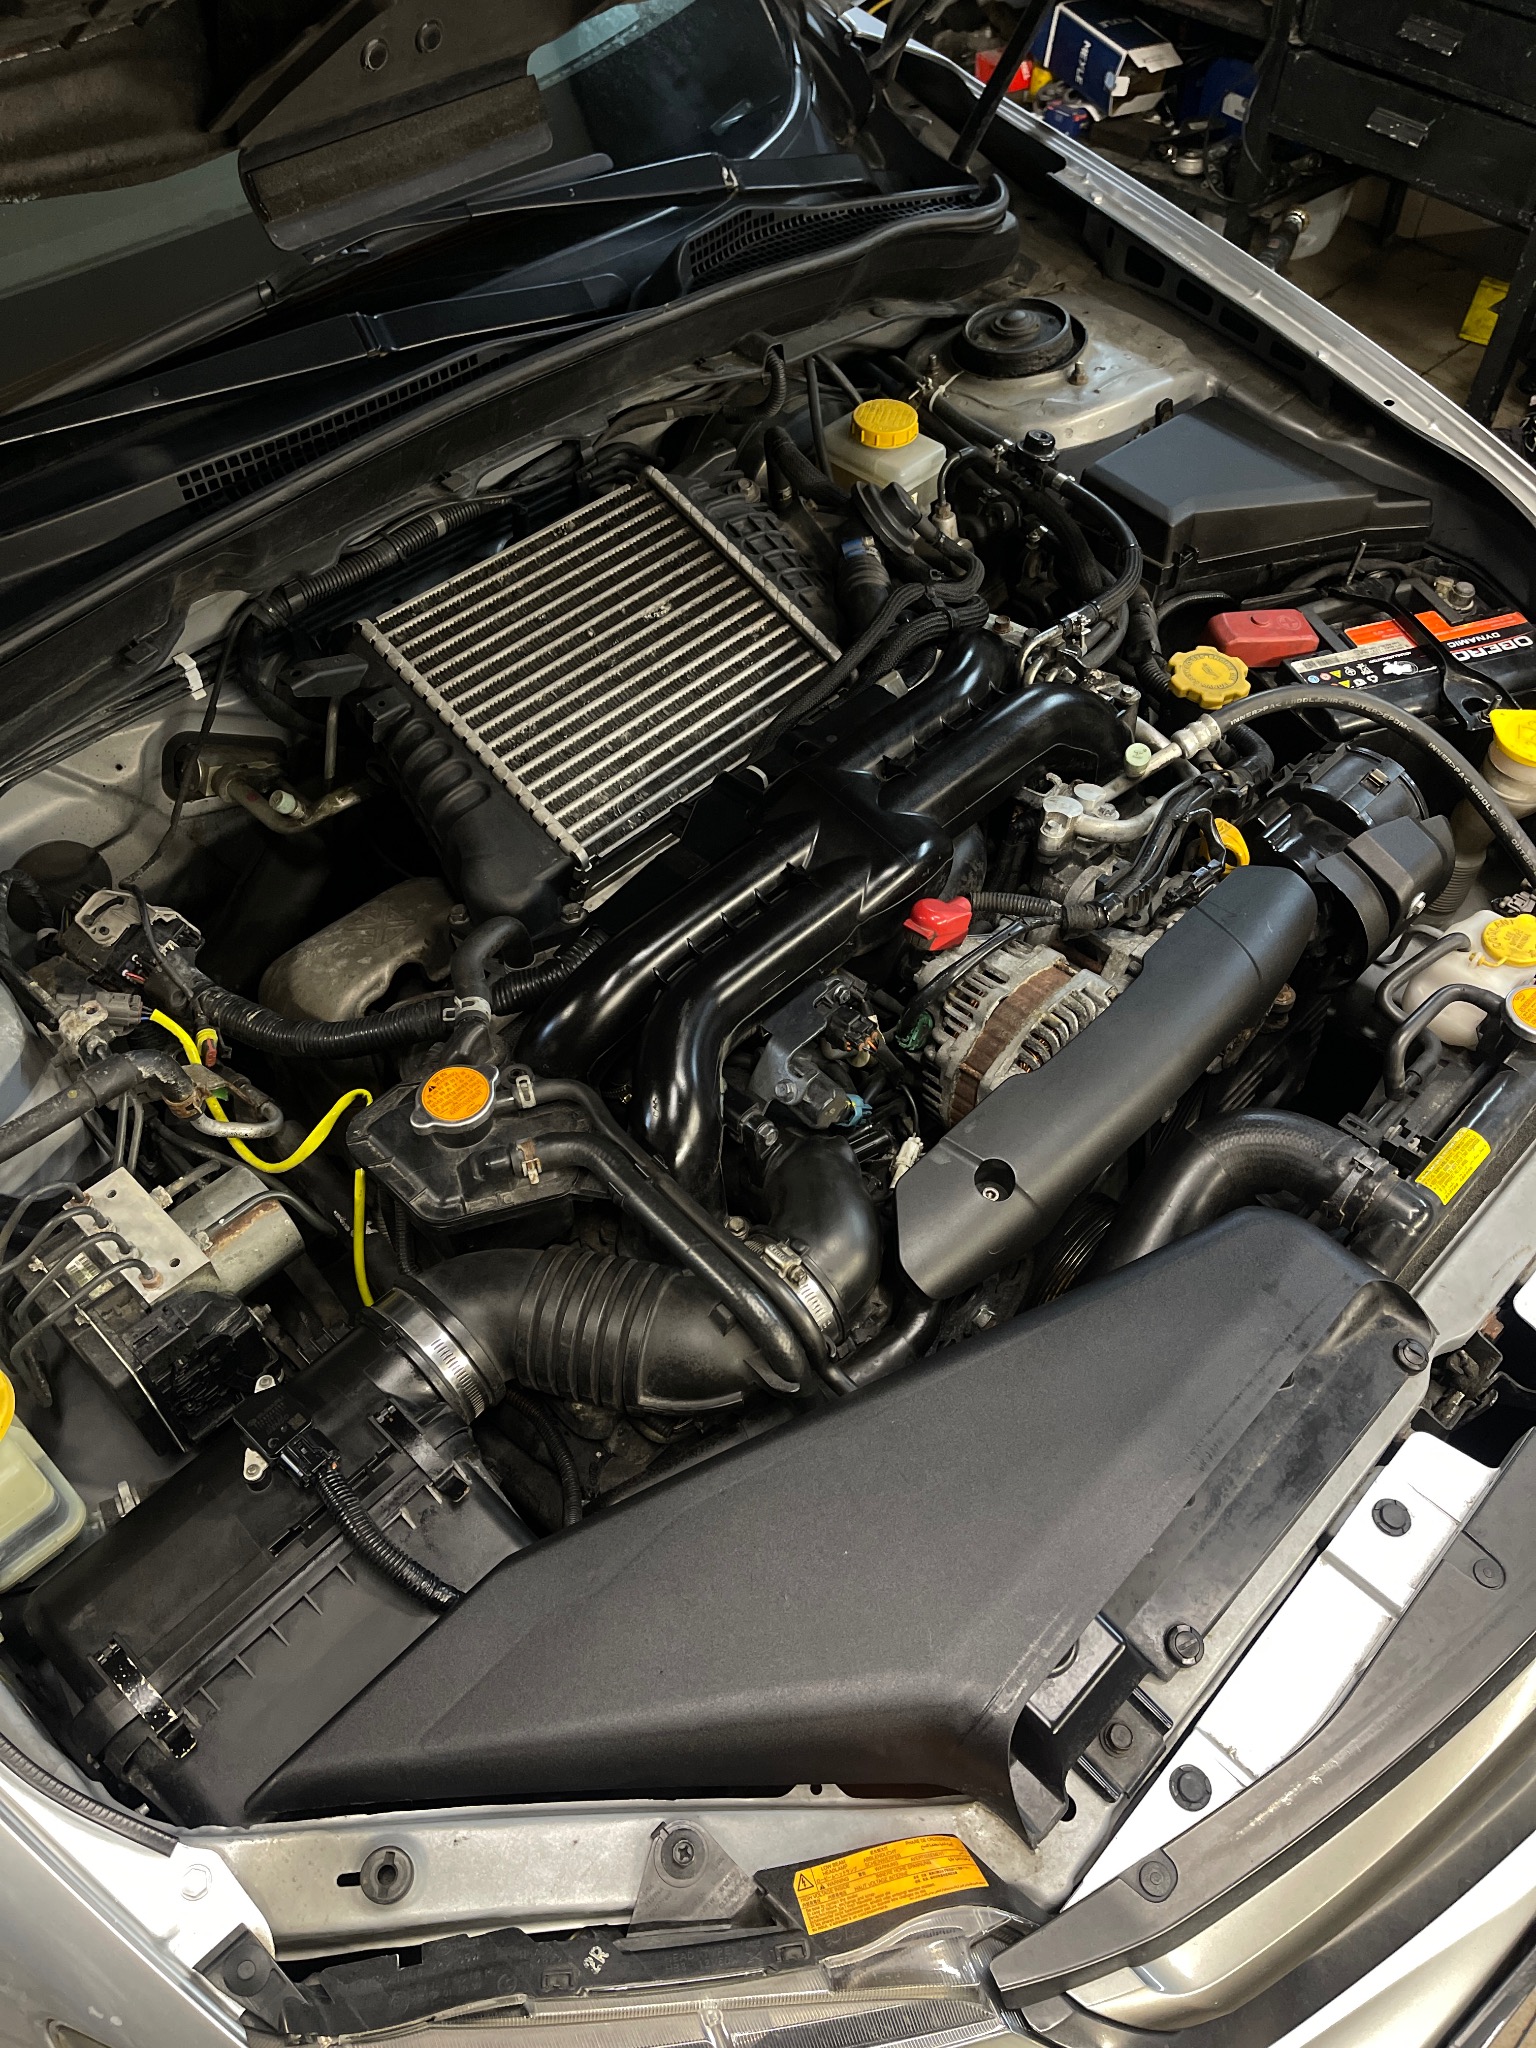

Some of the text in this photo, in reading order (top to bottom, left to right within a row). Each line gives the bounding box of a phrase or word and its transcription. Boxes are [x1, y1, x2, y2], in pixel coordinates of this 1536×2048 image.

[1447, 632, 1501, 648] DYNAMIC
[1451, 635, 1534, 662] OBERO
[1427, 742, 1471, 785] INNER>PA<
